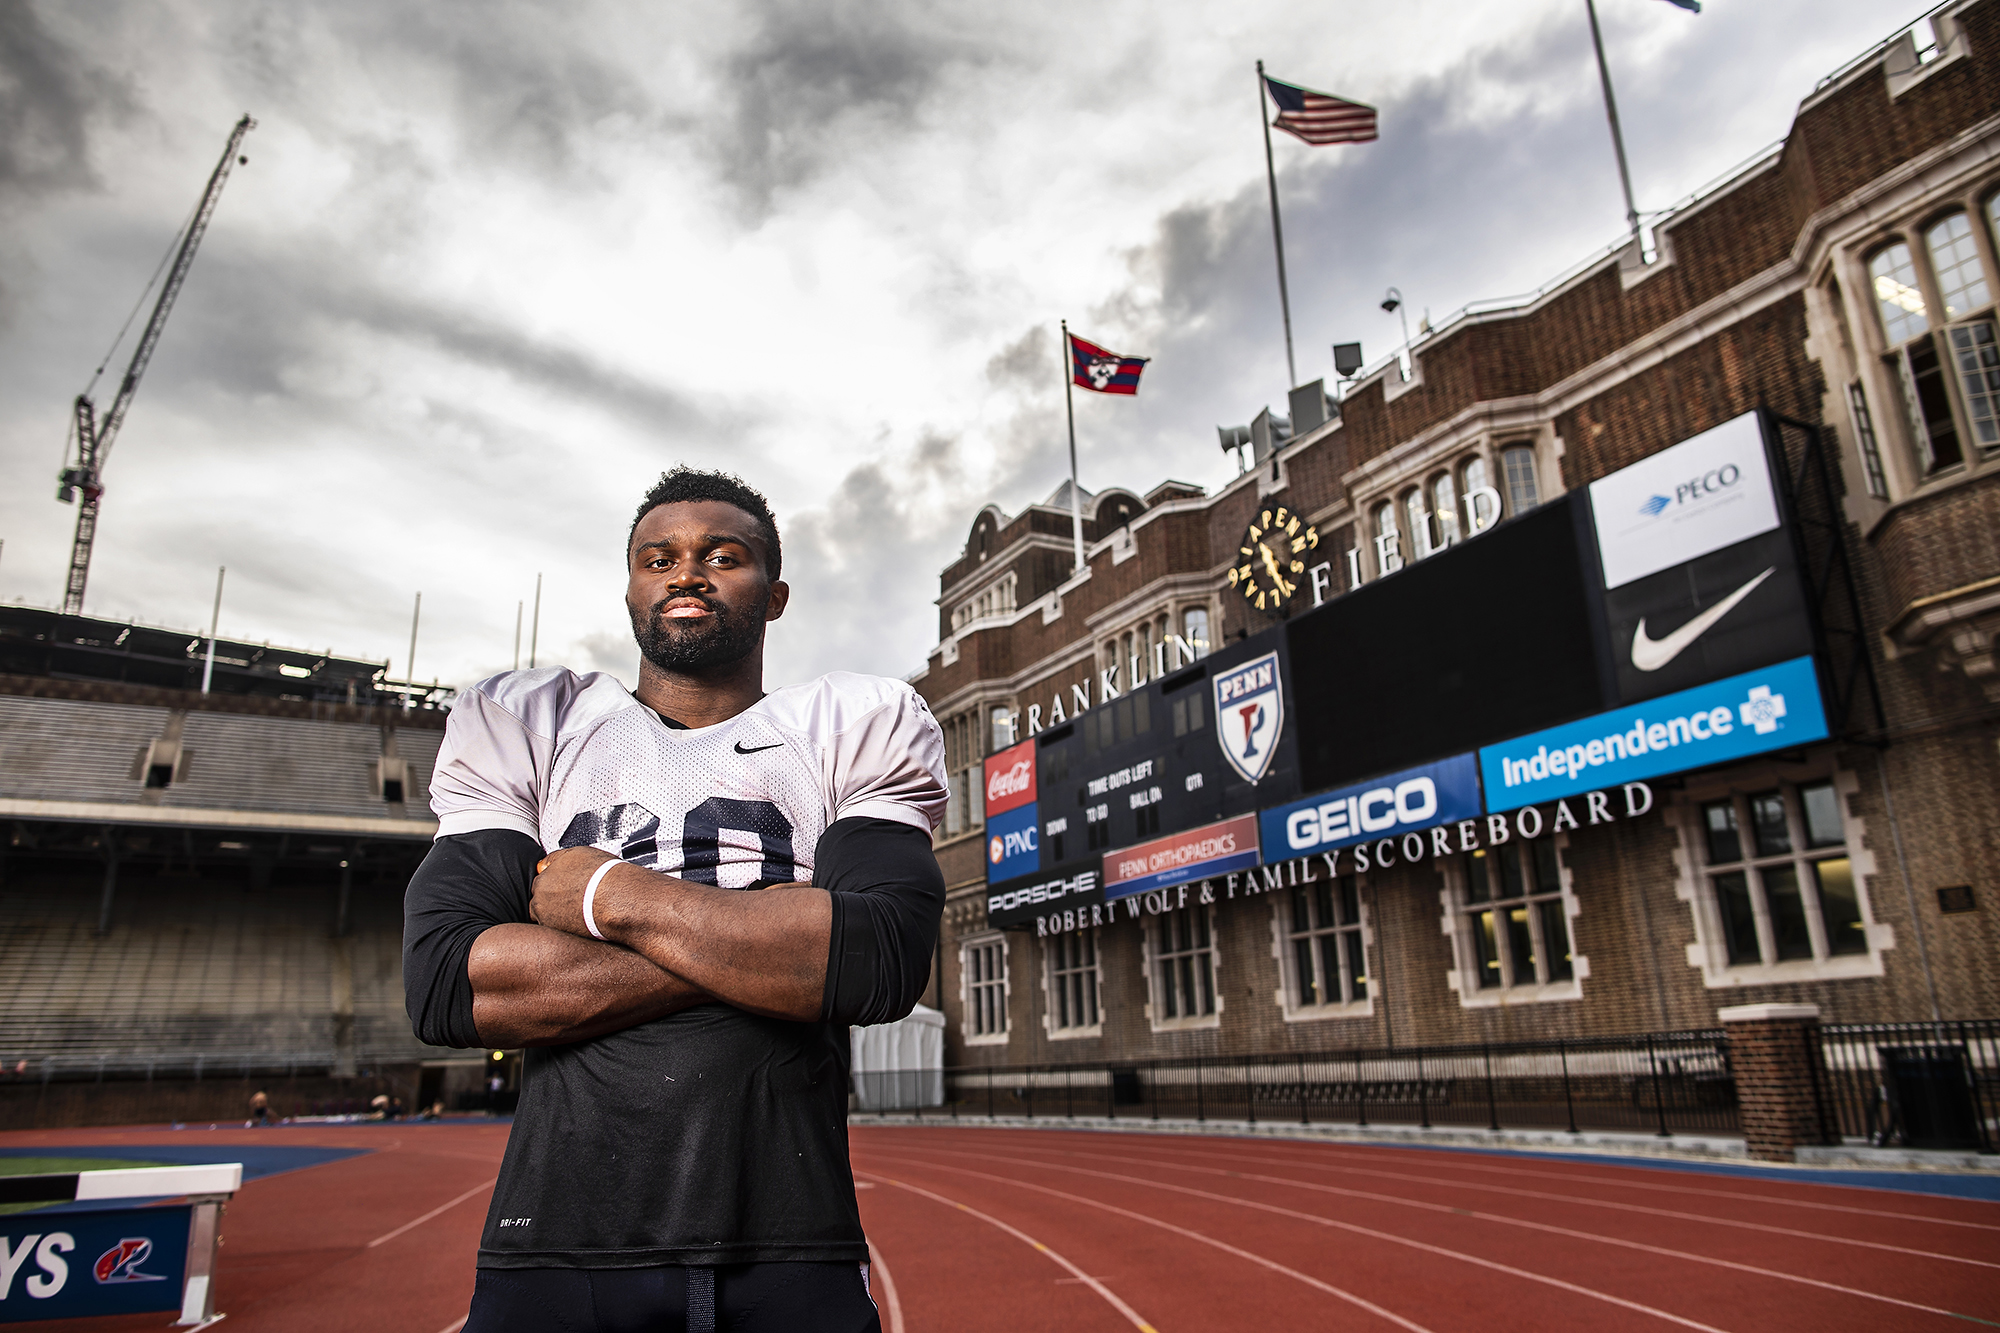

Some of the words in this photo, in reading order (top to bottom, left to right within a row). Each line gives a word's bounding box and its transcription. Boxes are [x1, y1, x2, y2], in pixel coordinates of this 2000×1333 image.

[1676, 463, 1740, 505] PECO
[1308, 486, 1502, 609] FIELD
[1008, 626, 1198, 745] FRANKLIN
[1220, 662, 1273, 703] PENN
[1239, 703, 1265, 759] P
[1502, 706, 1734, 788] Independence
[1088, 776, 1109, 797] TIME
[1108, 767, 1132, 790] OUTS
[1131, 760, 1154, 783] LEFT
[1129, 790, 1150, 810] BALL
[1149, 785, 1163, 804] ON
[1086, 808, 1098, 824] TO
[1286, 776, 1438, 850] GEICO
[1004, 825, 1039, 859] PNC
[1036, 900, 1117, 938] ROBERT
[1125, 884, 1189, 918] WOLF
[1200, 879, 1217, 905] &
[1226, 850, 1340, 899] FAMILY
[1353, 781, 1654, 873] SCOREBOARD
[1118, 857, 1149, 879] PENN
[1149, 833, 1237, 872] ORTHOPAEDICS
[988, 870, 1096, 915] PORSCHE
[499, 1218, 532, 1228] DRI-FIT
